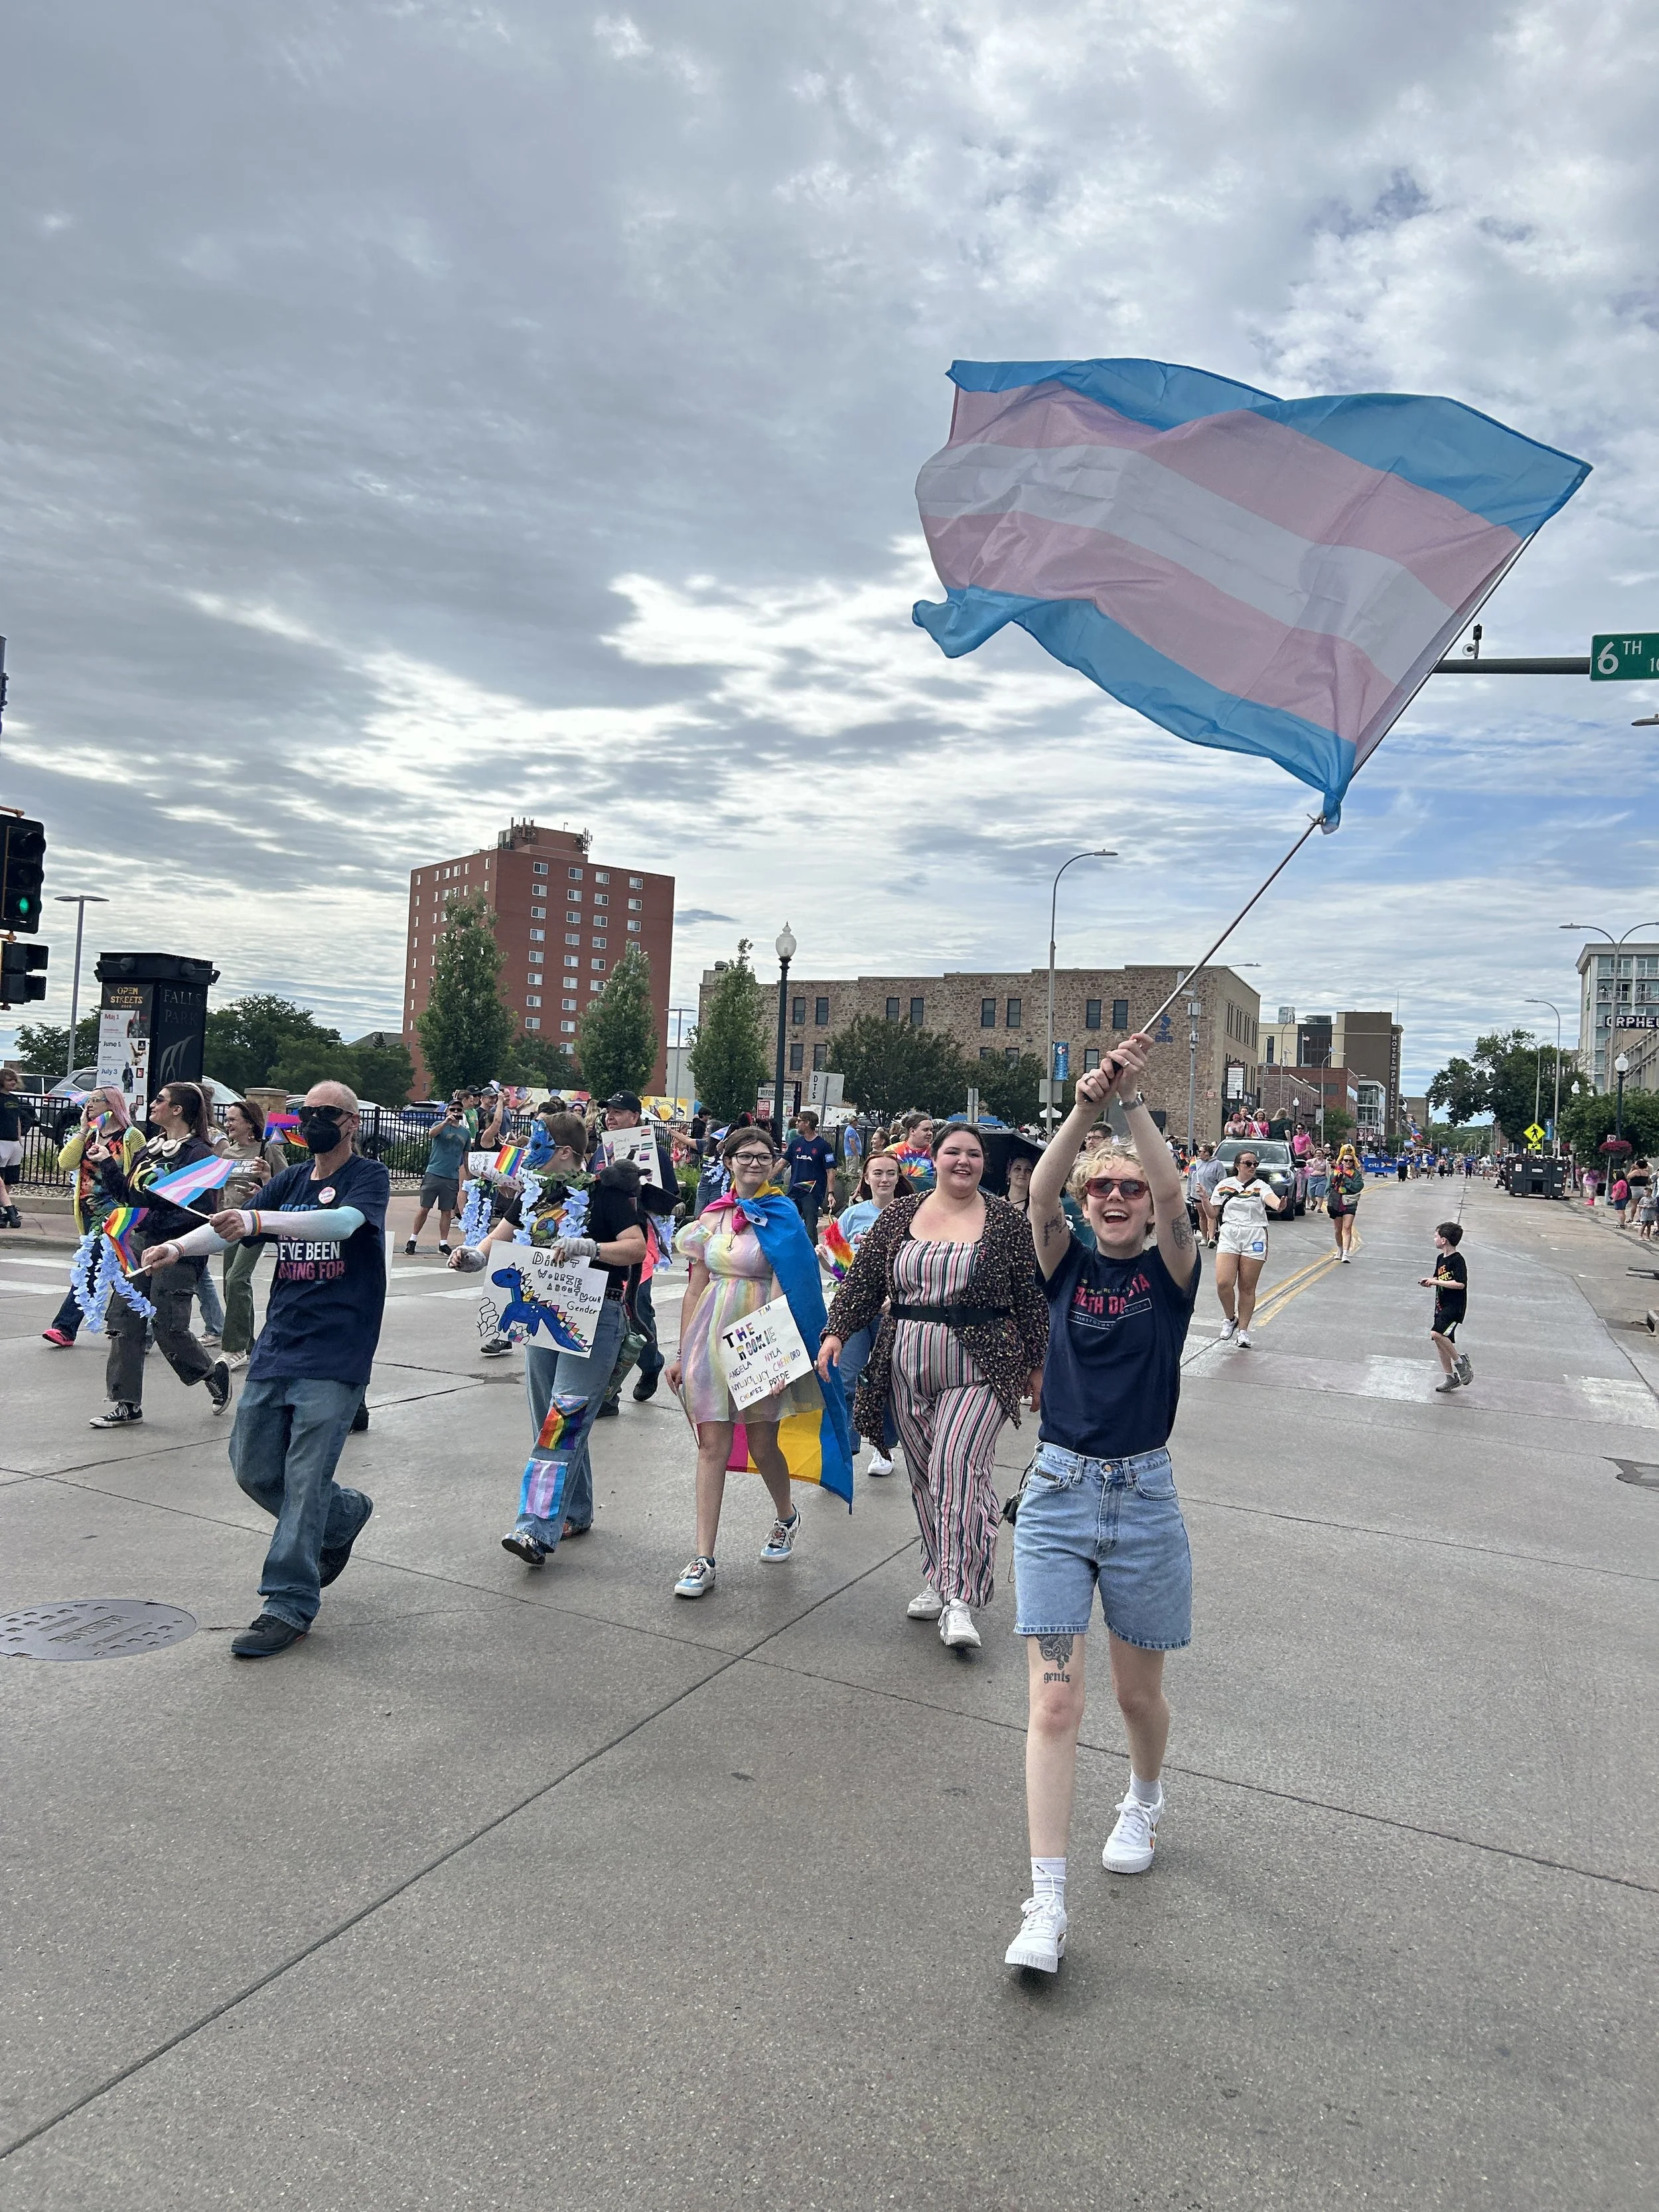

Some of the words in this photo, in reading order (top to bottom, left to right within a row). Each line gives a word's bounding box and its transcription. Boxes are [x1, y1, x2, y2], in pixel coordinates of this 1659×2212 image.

[164, 989, 202, 1005] FALLS
[165, 1009, 198, 1025] PARK
[305, 1241, 340, 1260] BEEN
[319, 1260, 346, 1280] FOR
[567, 1301, 597, 1315] Gender
[758, 1305, 772, 1317] TIM
[722, 1322, 755, 1349] THE
[736, 1327, 777, 1361] ROOKIE
[729, 1361, 753, 1380] ANGELA
[764, 1347, 782, 1362] NYLA
[752, 1369, 770, 1385] LUCY
[1043, 1670, 1070, 1684] gents
